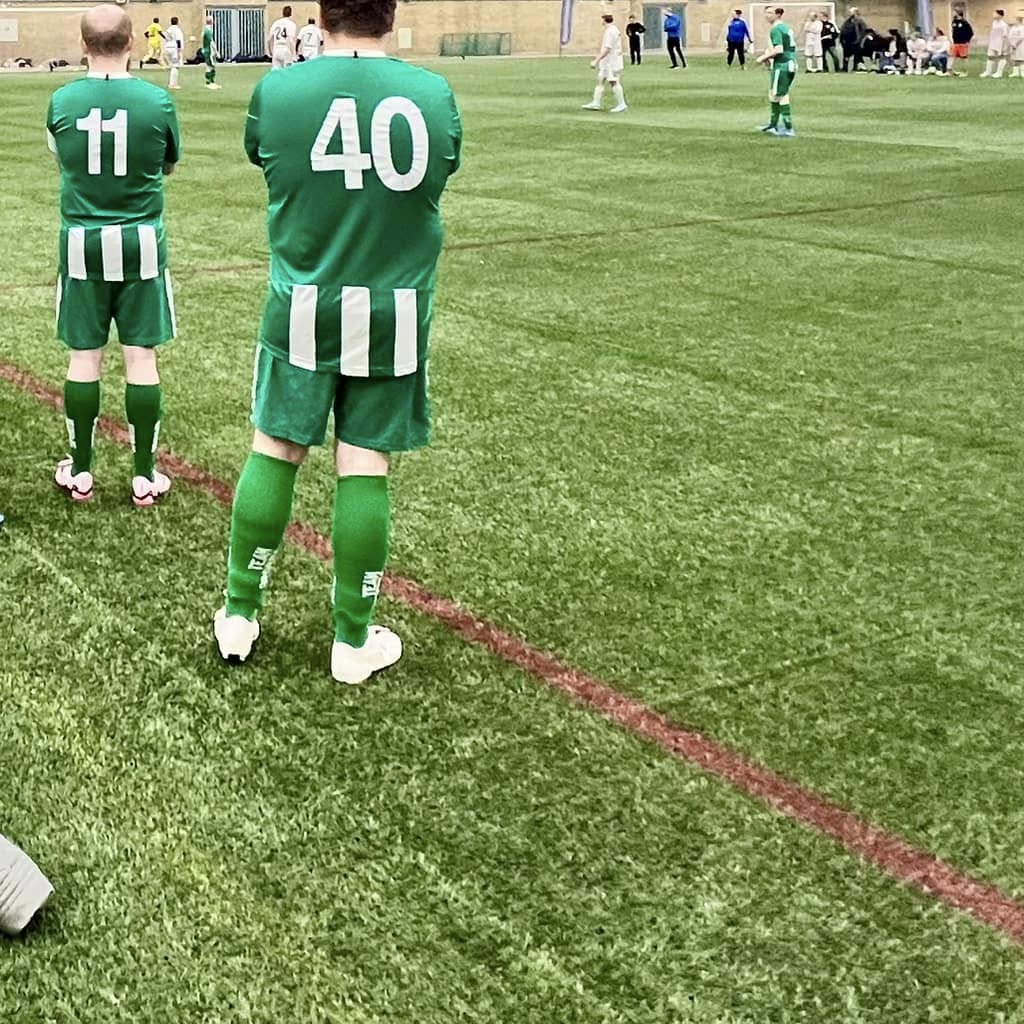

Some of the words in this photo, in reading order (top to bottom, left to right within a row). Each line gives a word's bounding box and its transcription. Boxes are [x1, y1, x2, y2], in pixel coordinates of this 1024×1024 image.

[275, 27, 287, 40] 24
[75, 107, 128, 176] 11
[310, 95, 430, 192] 40
